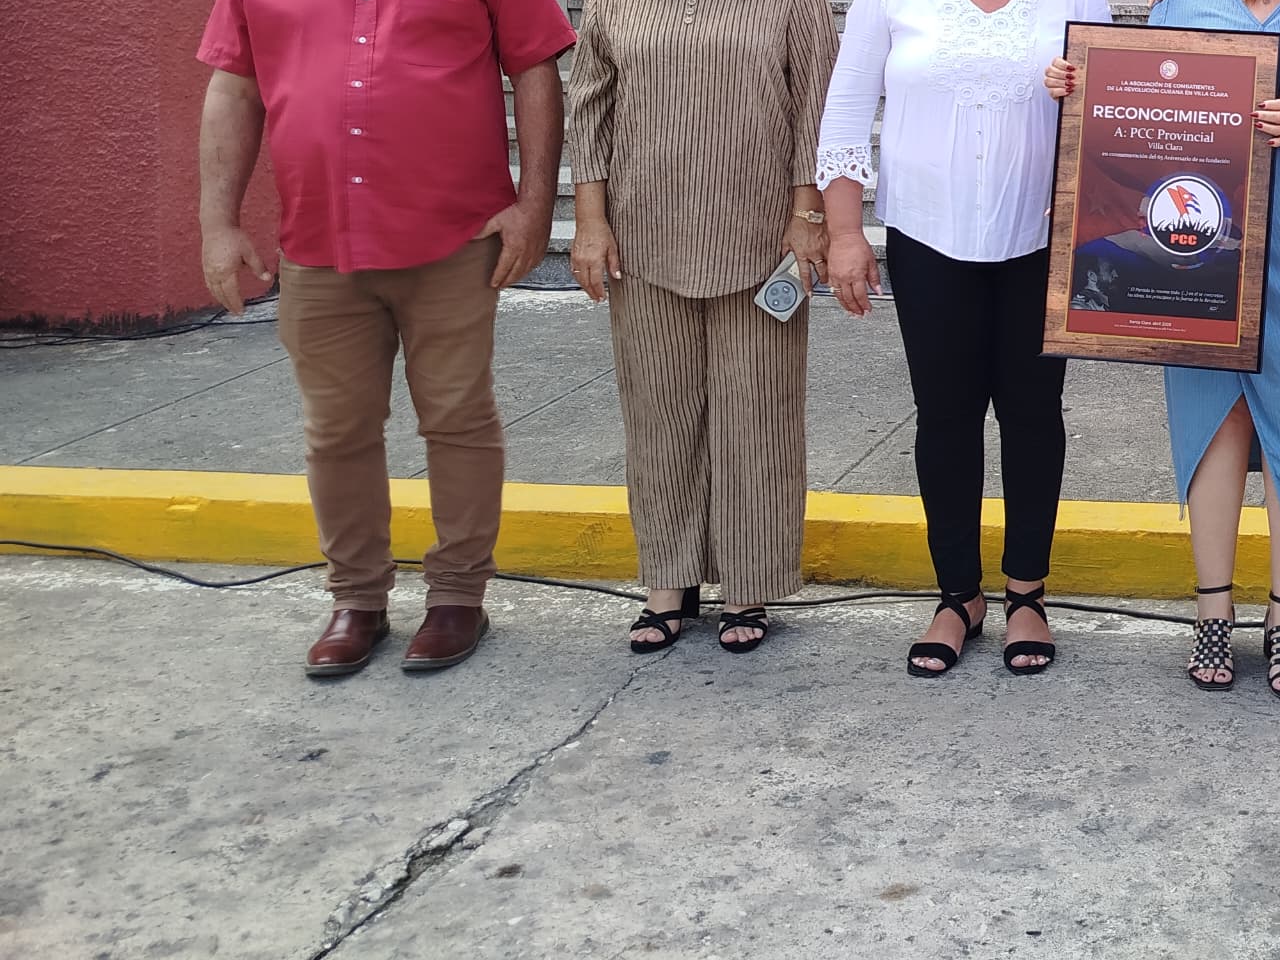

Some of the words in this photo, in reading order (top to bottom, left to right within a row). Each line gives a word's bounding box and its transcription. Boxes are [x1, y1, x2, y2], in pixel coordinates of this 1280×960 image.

[1093, 104, 1243, 126] RECONOCIMIENTO
[1114, 127, 1127, 138] A:
[1130, 127, 1155, 140] PCC
[1157, 128, 1214, 143] Provincial
[1147, 142, 1163, 150] Villa
[1165, 143, 1183, 152] Clara
[1170, 233, 1197, 246] PCC
